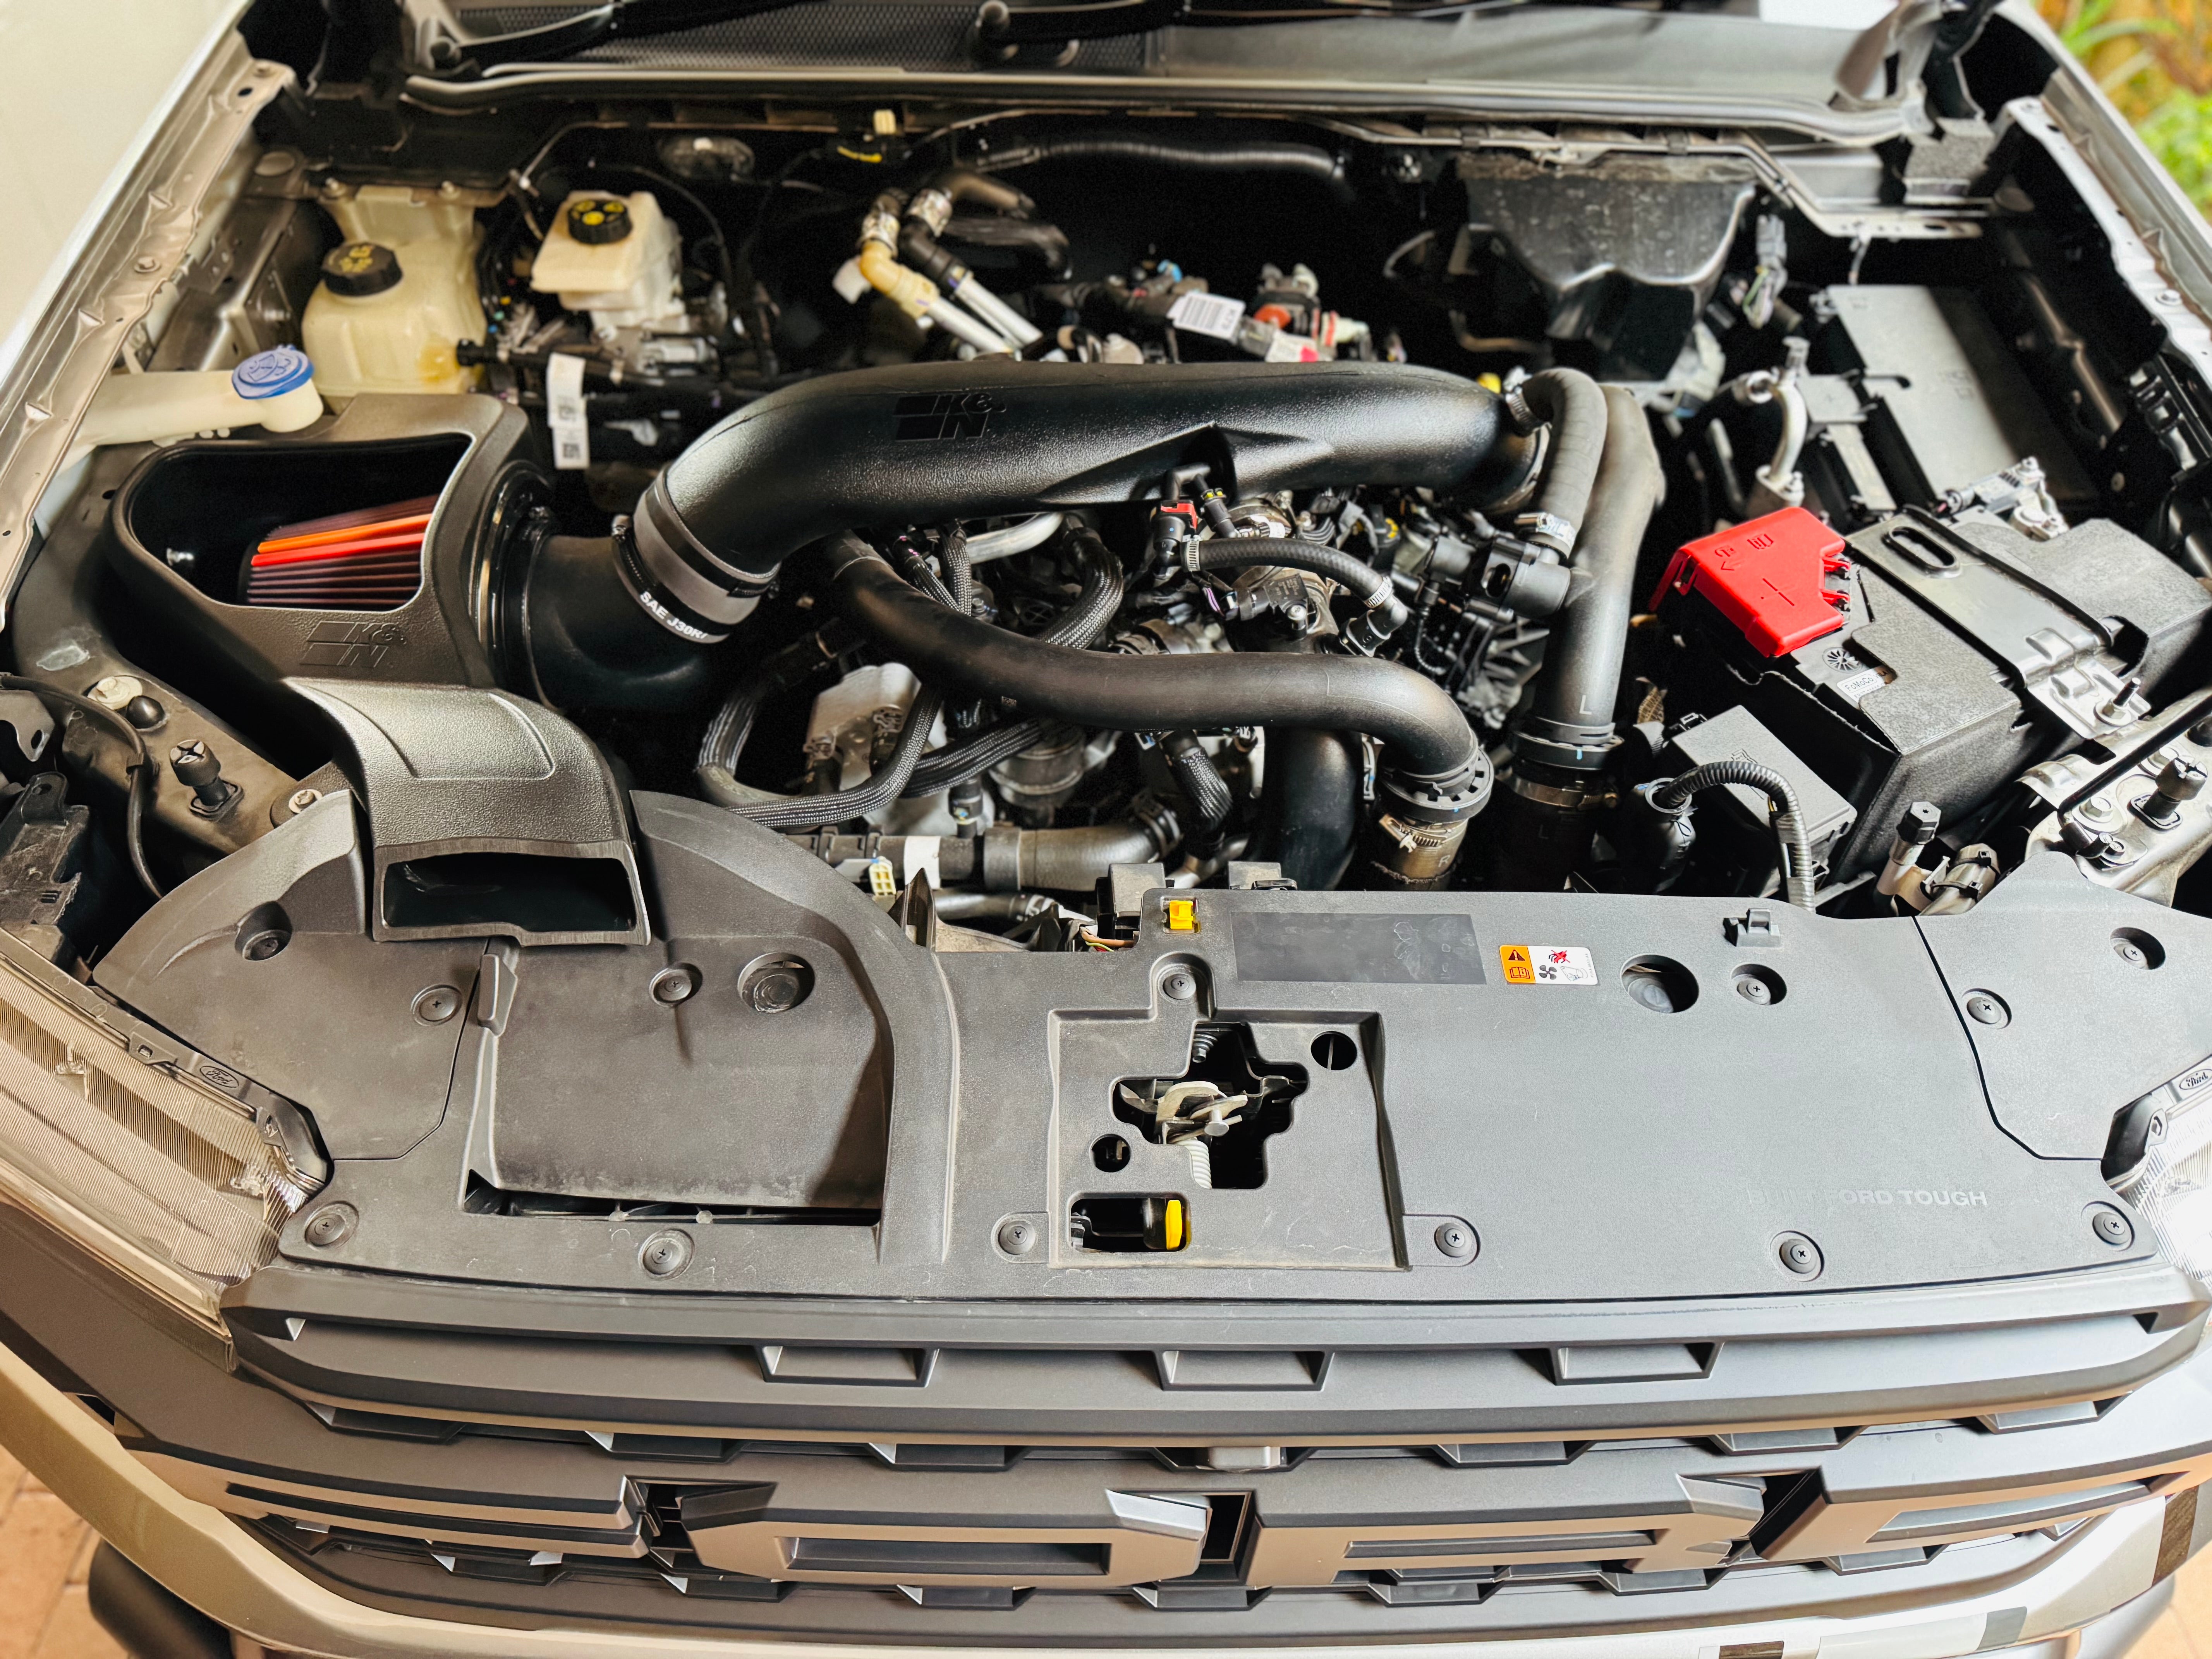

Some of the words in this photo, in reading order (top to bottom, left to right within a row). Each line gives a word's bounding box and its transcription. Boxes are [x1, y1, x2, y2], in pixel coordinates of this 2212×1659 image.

[640, 591, 669, 620] SAE
[1844, 677, 1874, 691] FoMoCo
[206, 1069, 233, 1085] Ford
[1823, 1189, 1894, 1205] FORD
[1898, 1190, 1989, 1206] TOUGH
